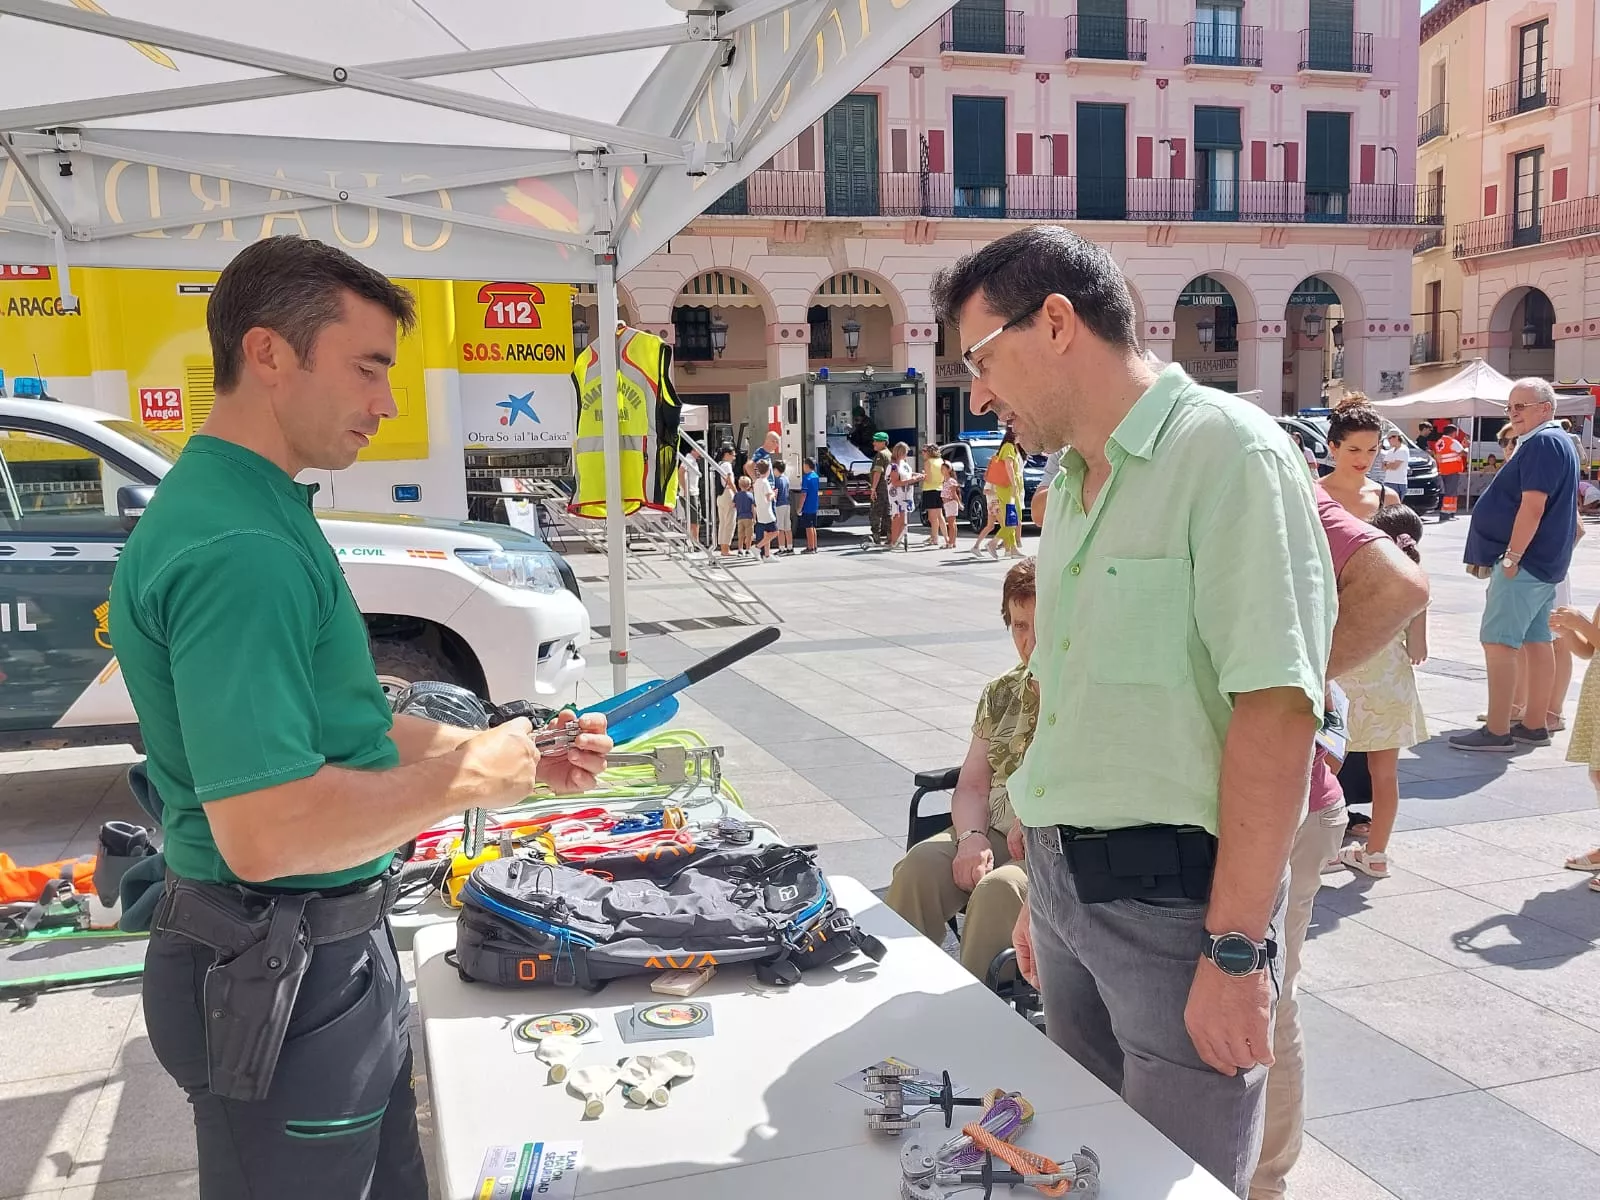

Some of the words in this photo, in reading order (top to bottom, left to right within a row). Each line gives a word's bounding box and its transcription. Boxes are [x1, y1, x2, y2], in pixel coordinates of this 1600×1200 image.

[492, 301, 532, 324] 112
[462, 343, 504, 362] S.O.S.
[506, 344, 566, 362] ARAGON
[143, 391, 179, 407] 112
[145, 408, 180, 420] Aragón
[468, 432, 494, 442] Obra
[351, 548, 387, 557] CIVIL
[565, 1150, 578, 1170] PLAN
